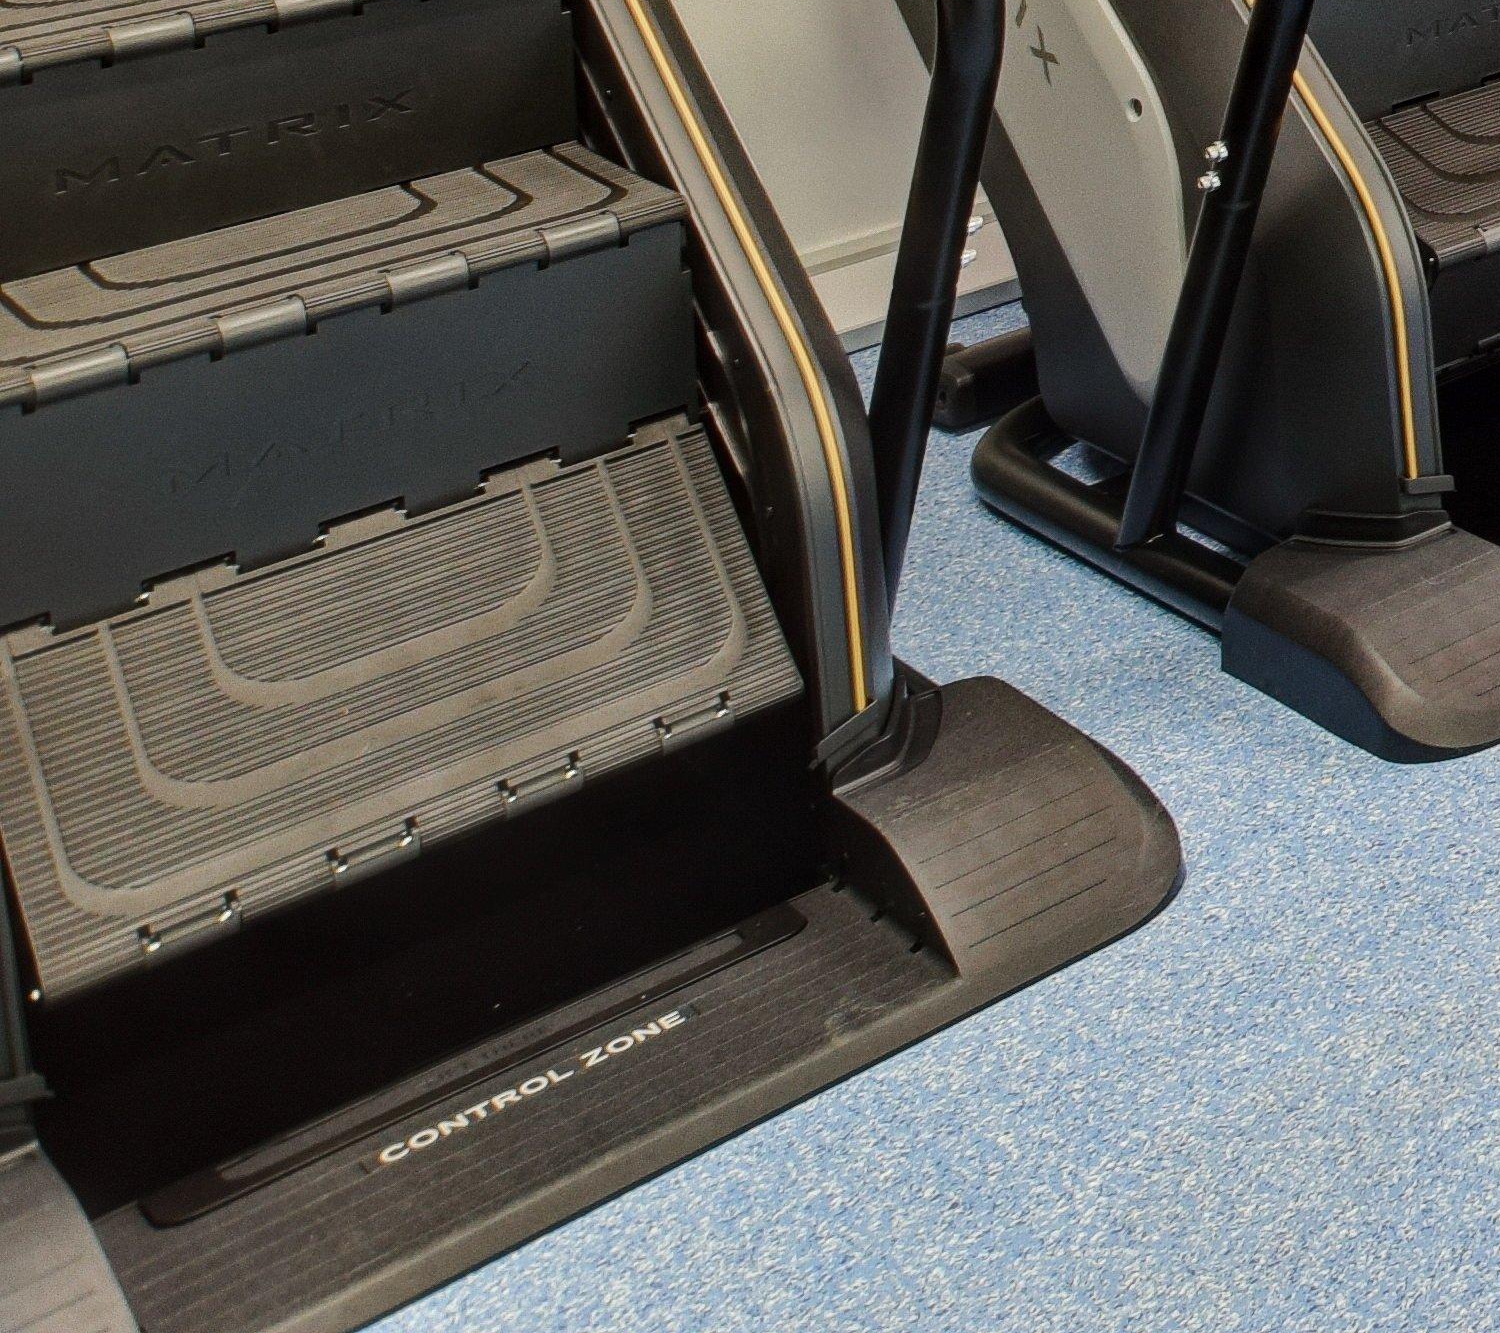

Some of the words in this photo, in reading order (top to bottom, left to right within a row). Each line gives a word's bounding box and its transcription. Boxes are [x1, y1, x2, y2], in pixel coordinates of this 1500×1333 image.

[54, 88, 413, 195] MATRIX
[378, 1068, 575, 1165] CONTROL
[579, 1009, 687, 1069] ZONE
